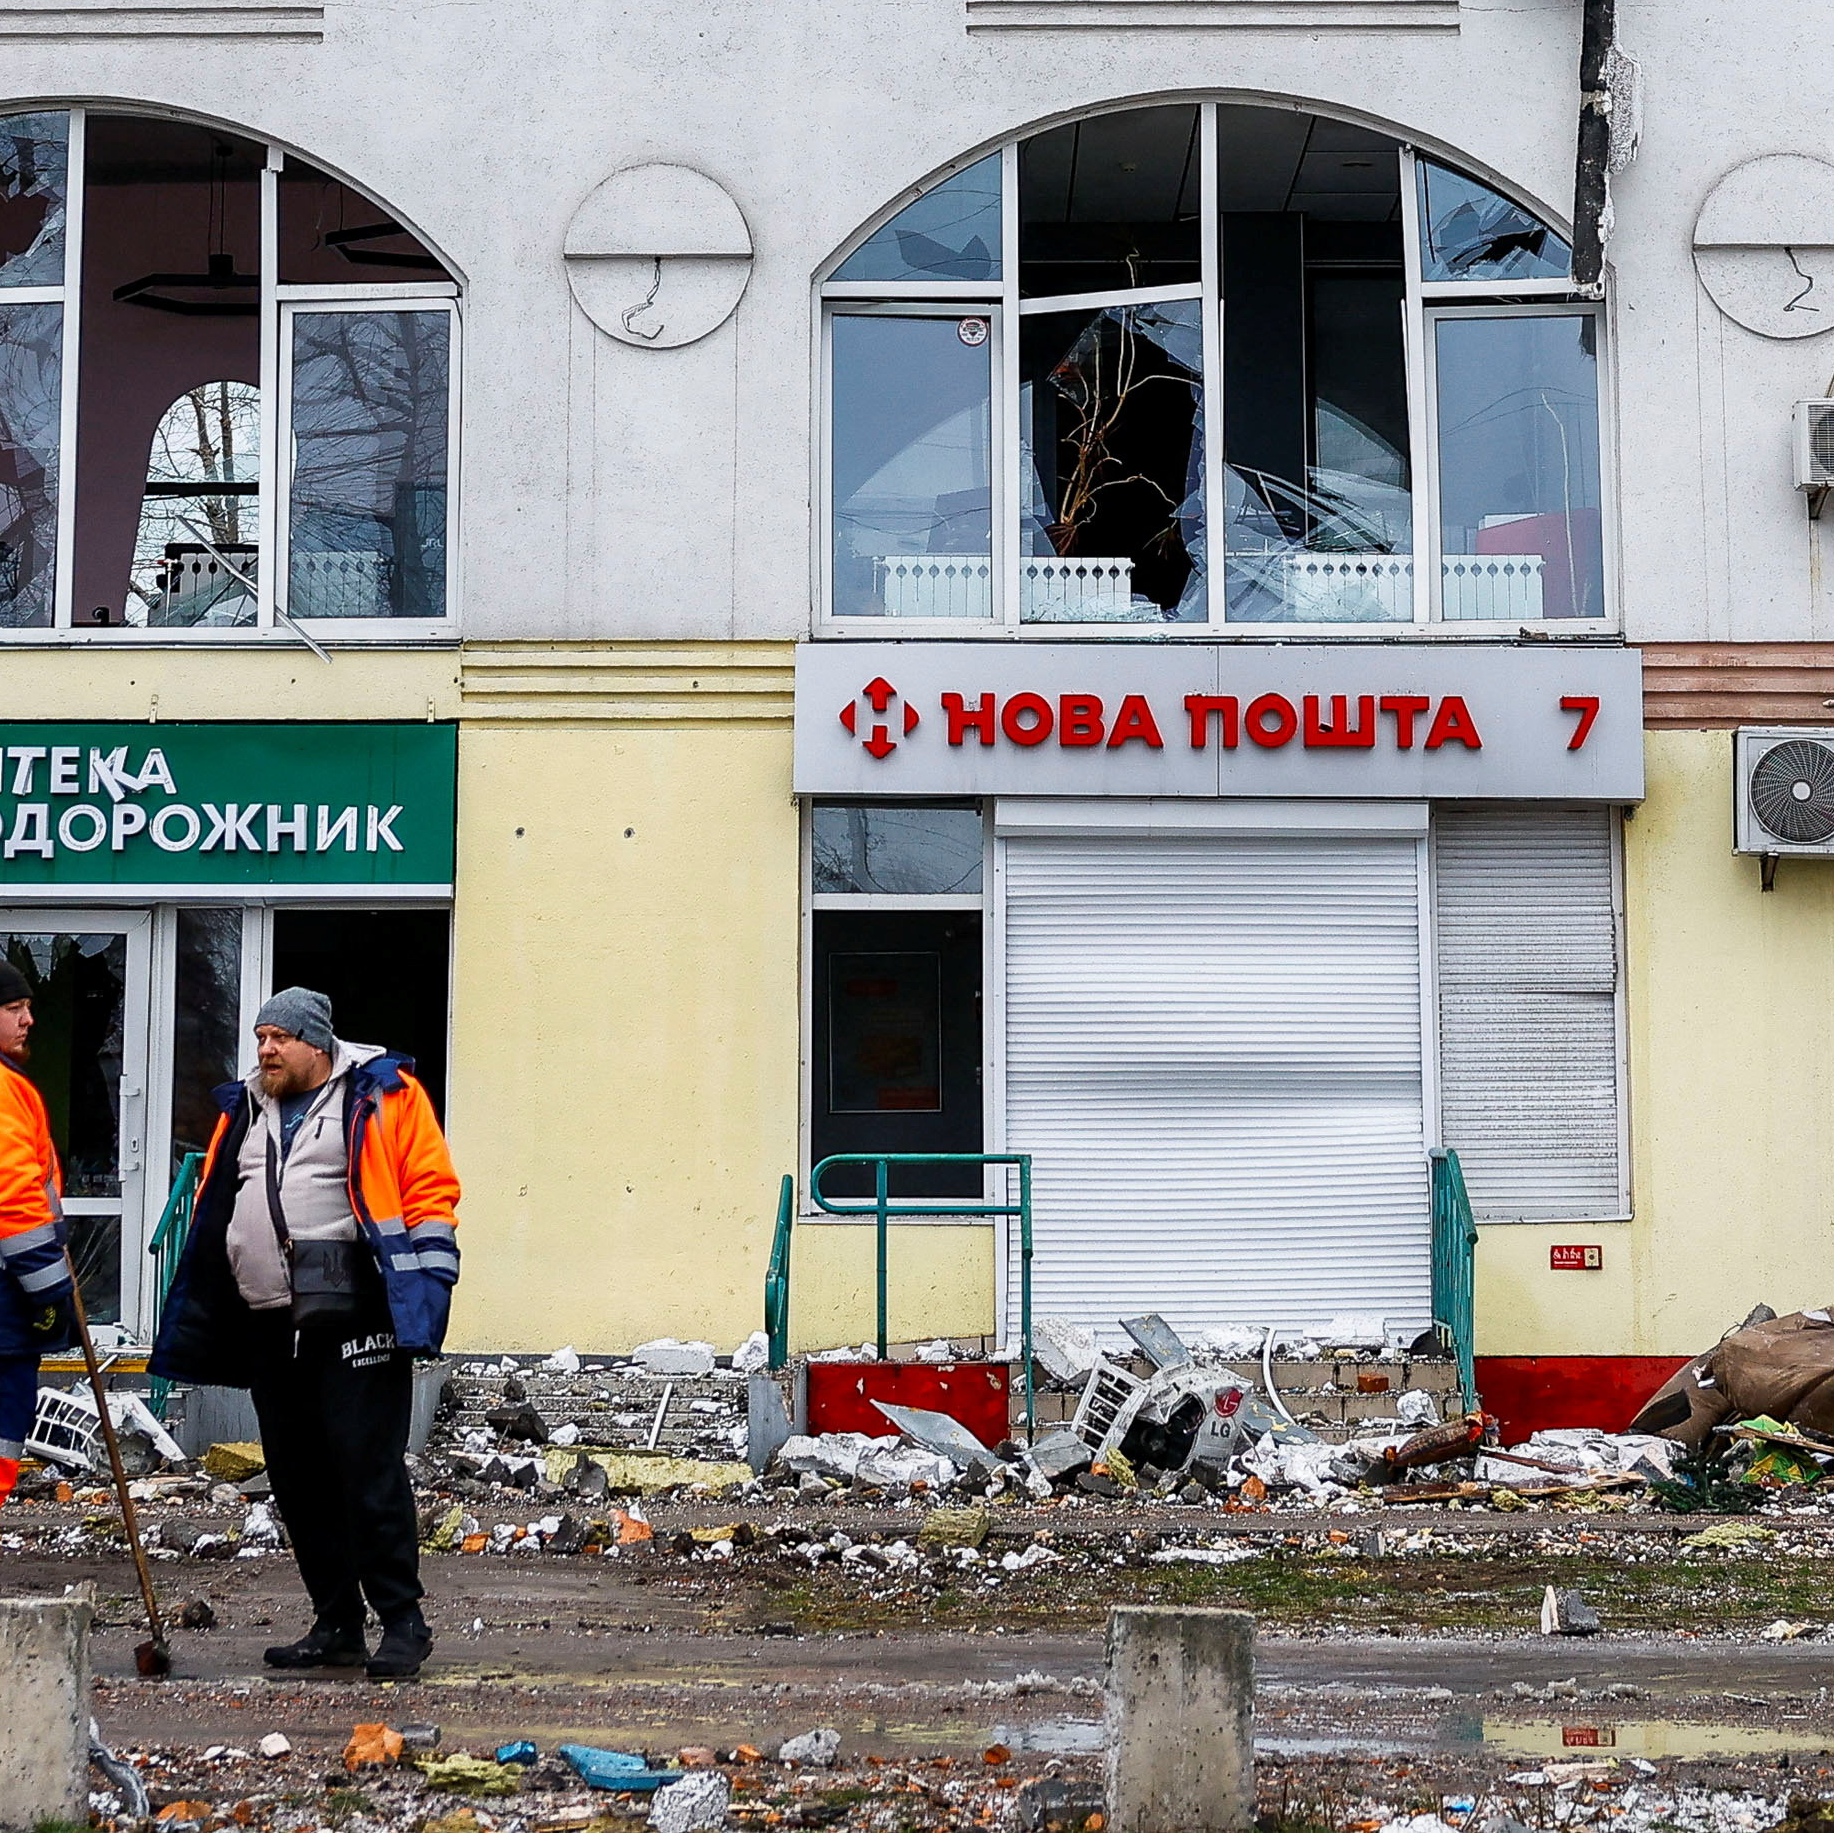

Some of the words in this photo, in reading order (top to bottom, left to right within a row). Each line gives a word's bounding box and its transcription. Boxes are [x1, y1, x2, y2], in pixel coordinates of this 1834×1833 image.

[940, 690, 1165, 749] НОВА
[1184, 691, 1483, 751] ПОШТА
[1559, 694, 1601, 751] 7
[341, 1332, 395, 1360] BLACK
[1210, 1421, 1232, 1439] LG
